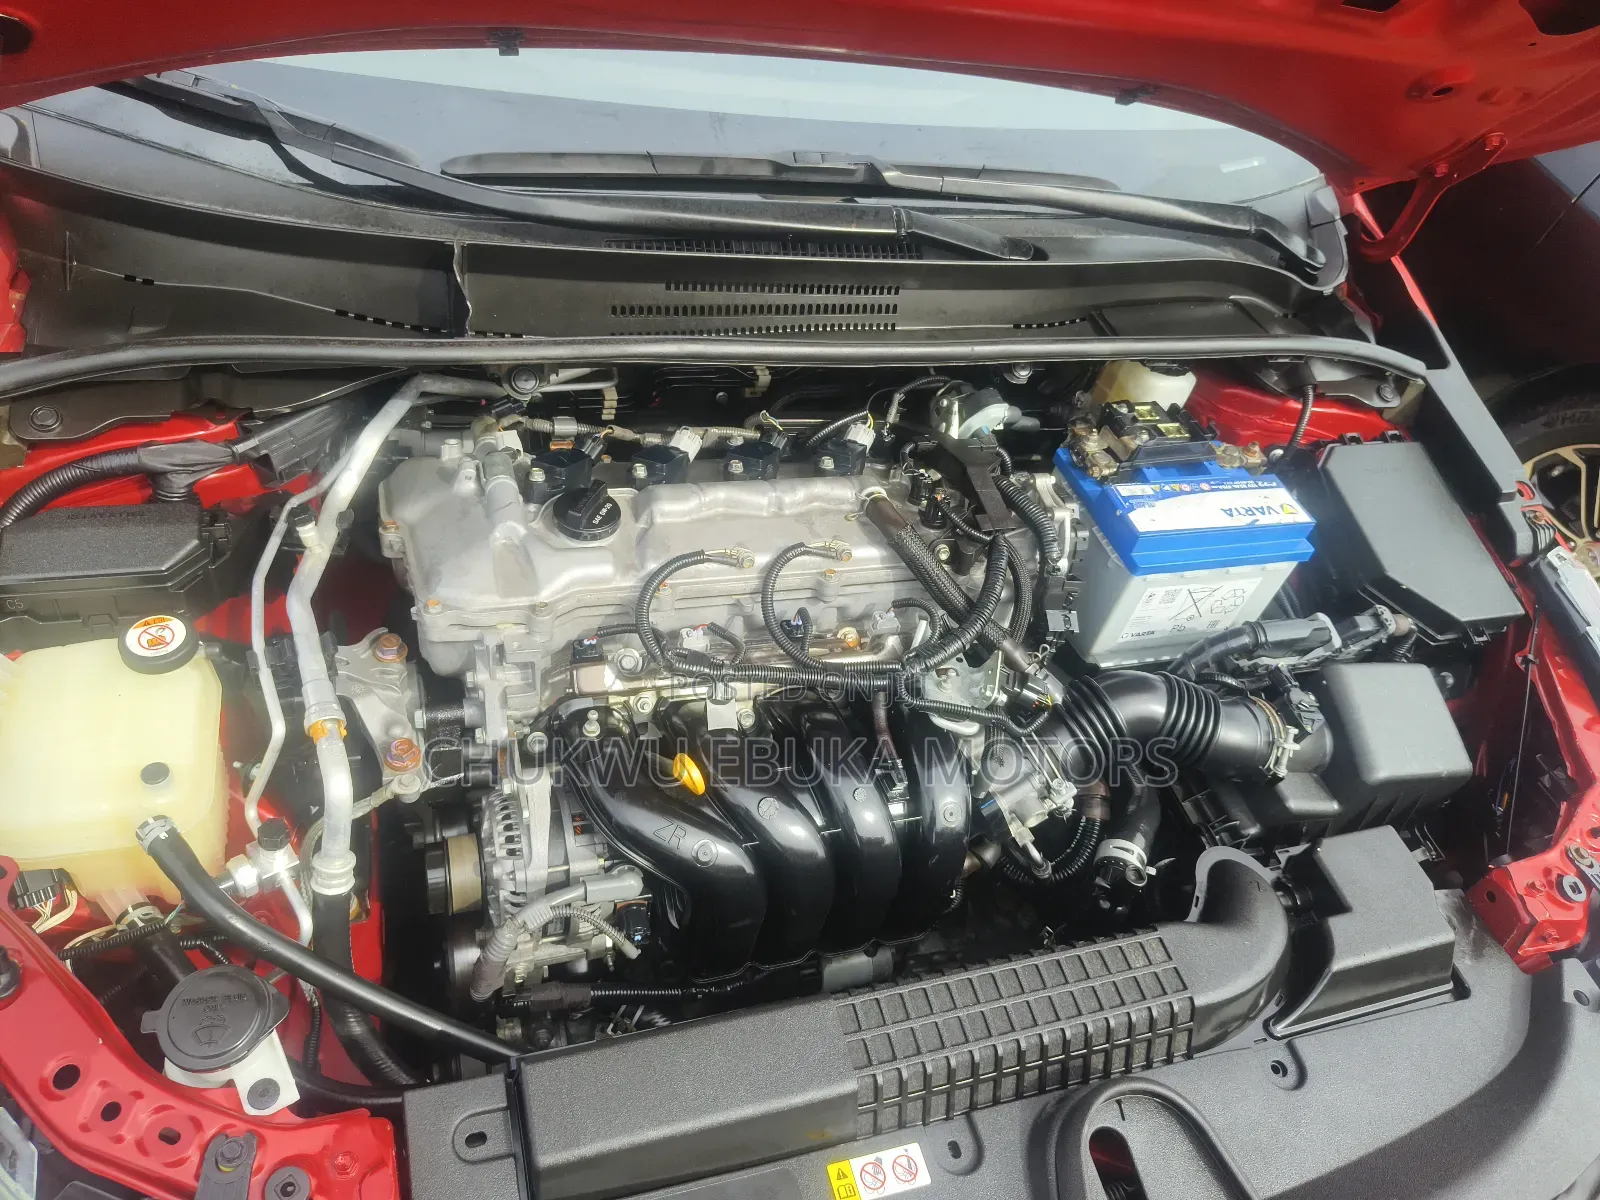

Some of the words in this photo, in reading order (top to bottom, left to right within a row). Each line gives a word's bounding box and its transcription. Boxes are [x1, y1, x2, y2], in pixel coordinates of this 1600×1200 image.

[1220, 506, 1281, 518] VARTA
[592, 515, 602, 525] SAE
[1170, 624, 1186, 632] Pb
[653, 815, 687, 850] ZR
